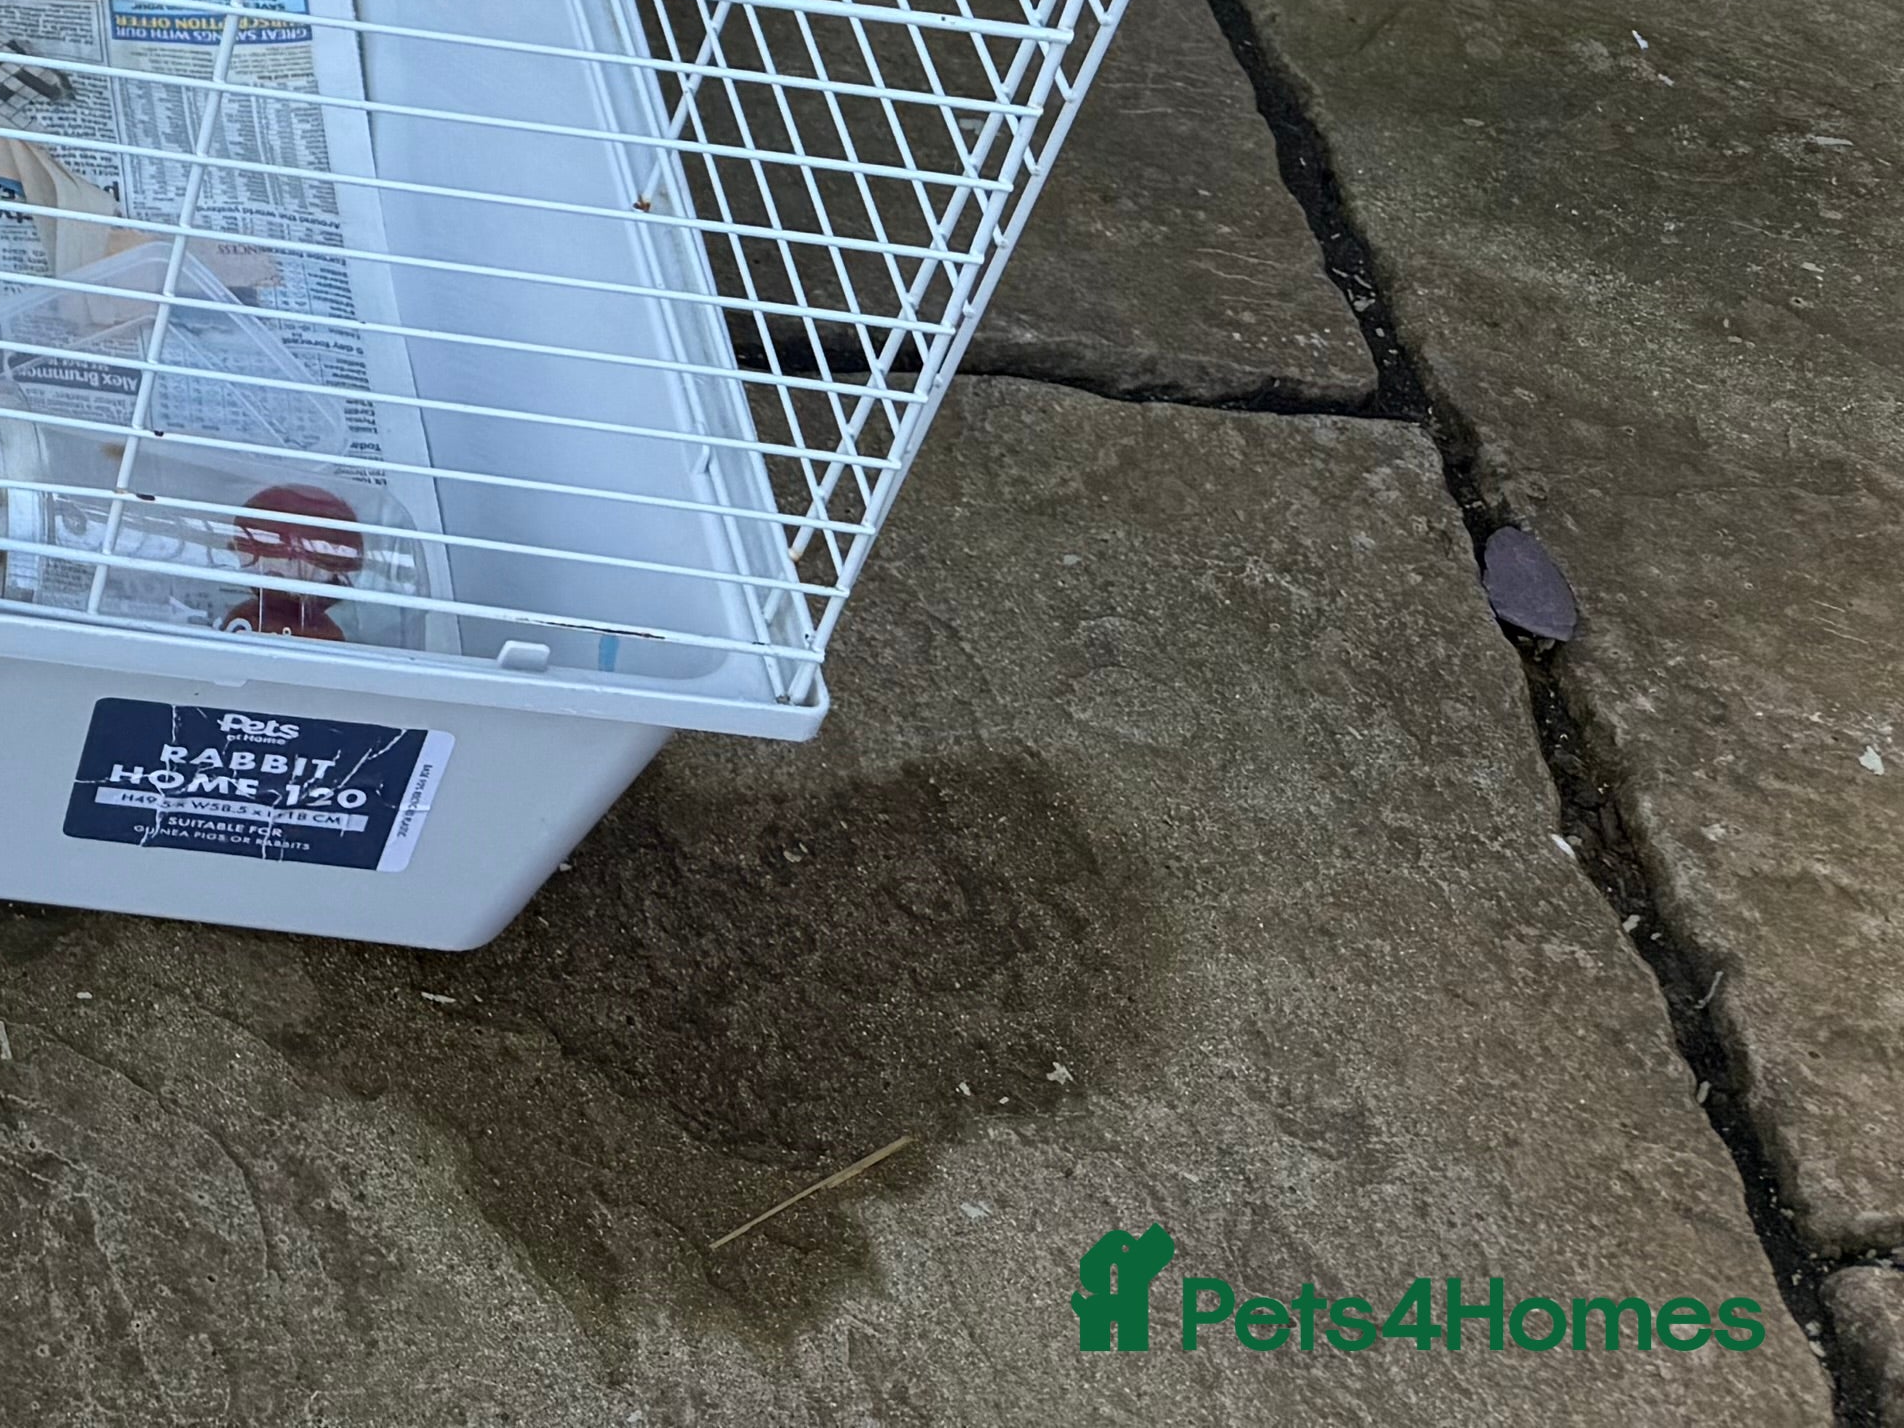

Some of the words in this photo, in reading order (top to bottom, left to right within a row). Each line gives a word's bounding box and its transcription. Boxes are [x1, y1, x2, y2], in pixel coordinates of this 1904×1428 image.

[115, 15, 171, 30] OFFER
[193, 30, 257, 42] SANGS
[259, 27, 307, 42] GREAT
[102, 373, 139, 391] Alex
[217, 713, 300, 740] Pets
[160, 743, 336, 780] RABBIT
[109, 764, 259, 796] HOME
[284, 784, 367, 809] 120
[168, 816, 244, 835] SUITABLE
[249, 825, 283, 838] FOR
[313, 813, 341, 825] CM
[133, 825, 190, 838] GUNEA
